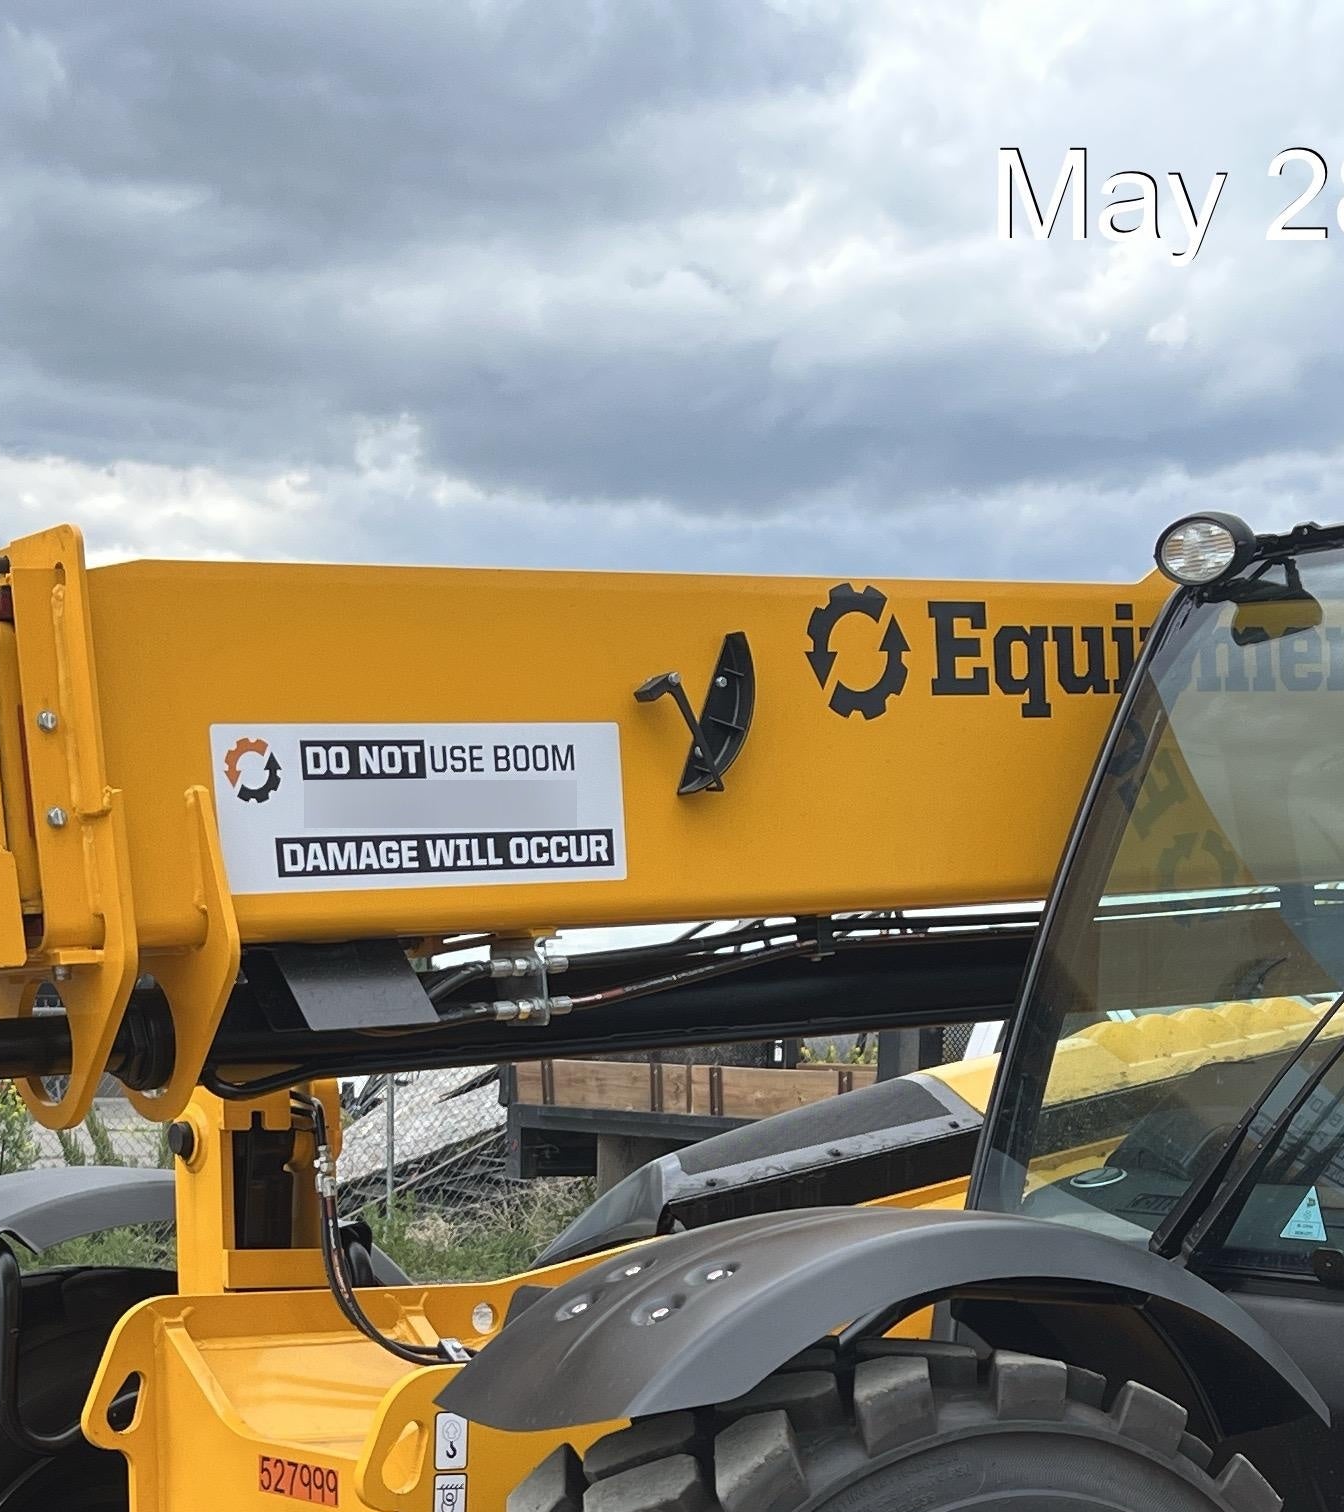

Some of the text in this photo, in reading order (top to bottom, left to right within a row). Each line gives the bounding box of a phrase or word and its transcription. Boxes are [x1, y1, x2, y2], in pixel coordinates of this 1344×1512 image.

[305, 744, 576, 775] DO NOT USE BOOM
[283, 834, 610, 872] DAMAGE WILL OCCUR
[260, 1457, 339, 1506] 527999
